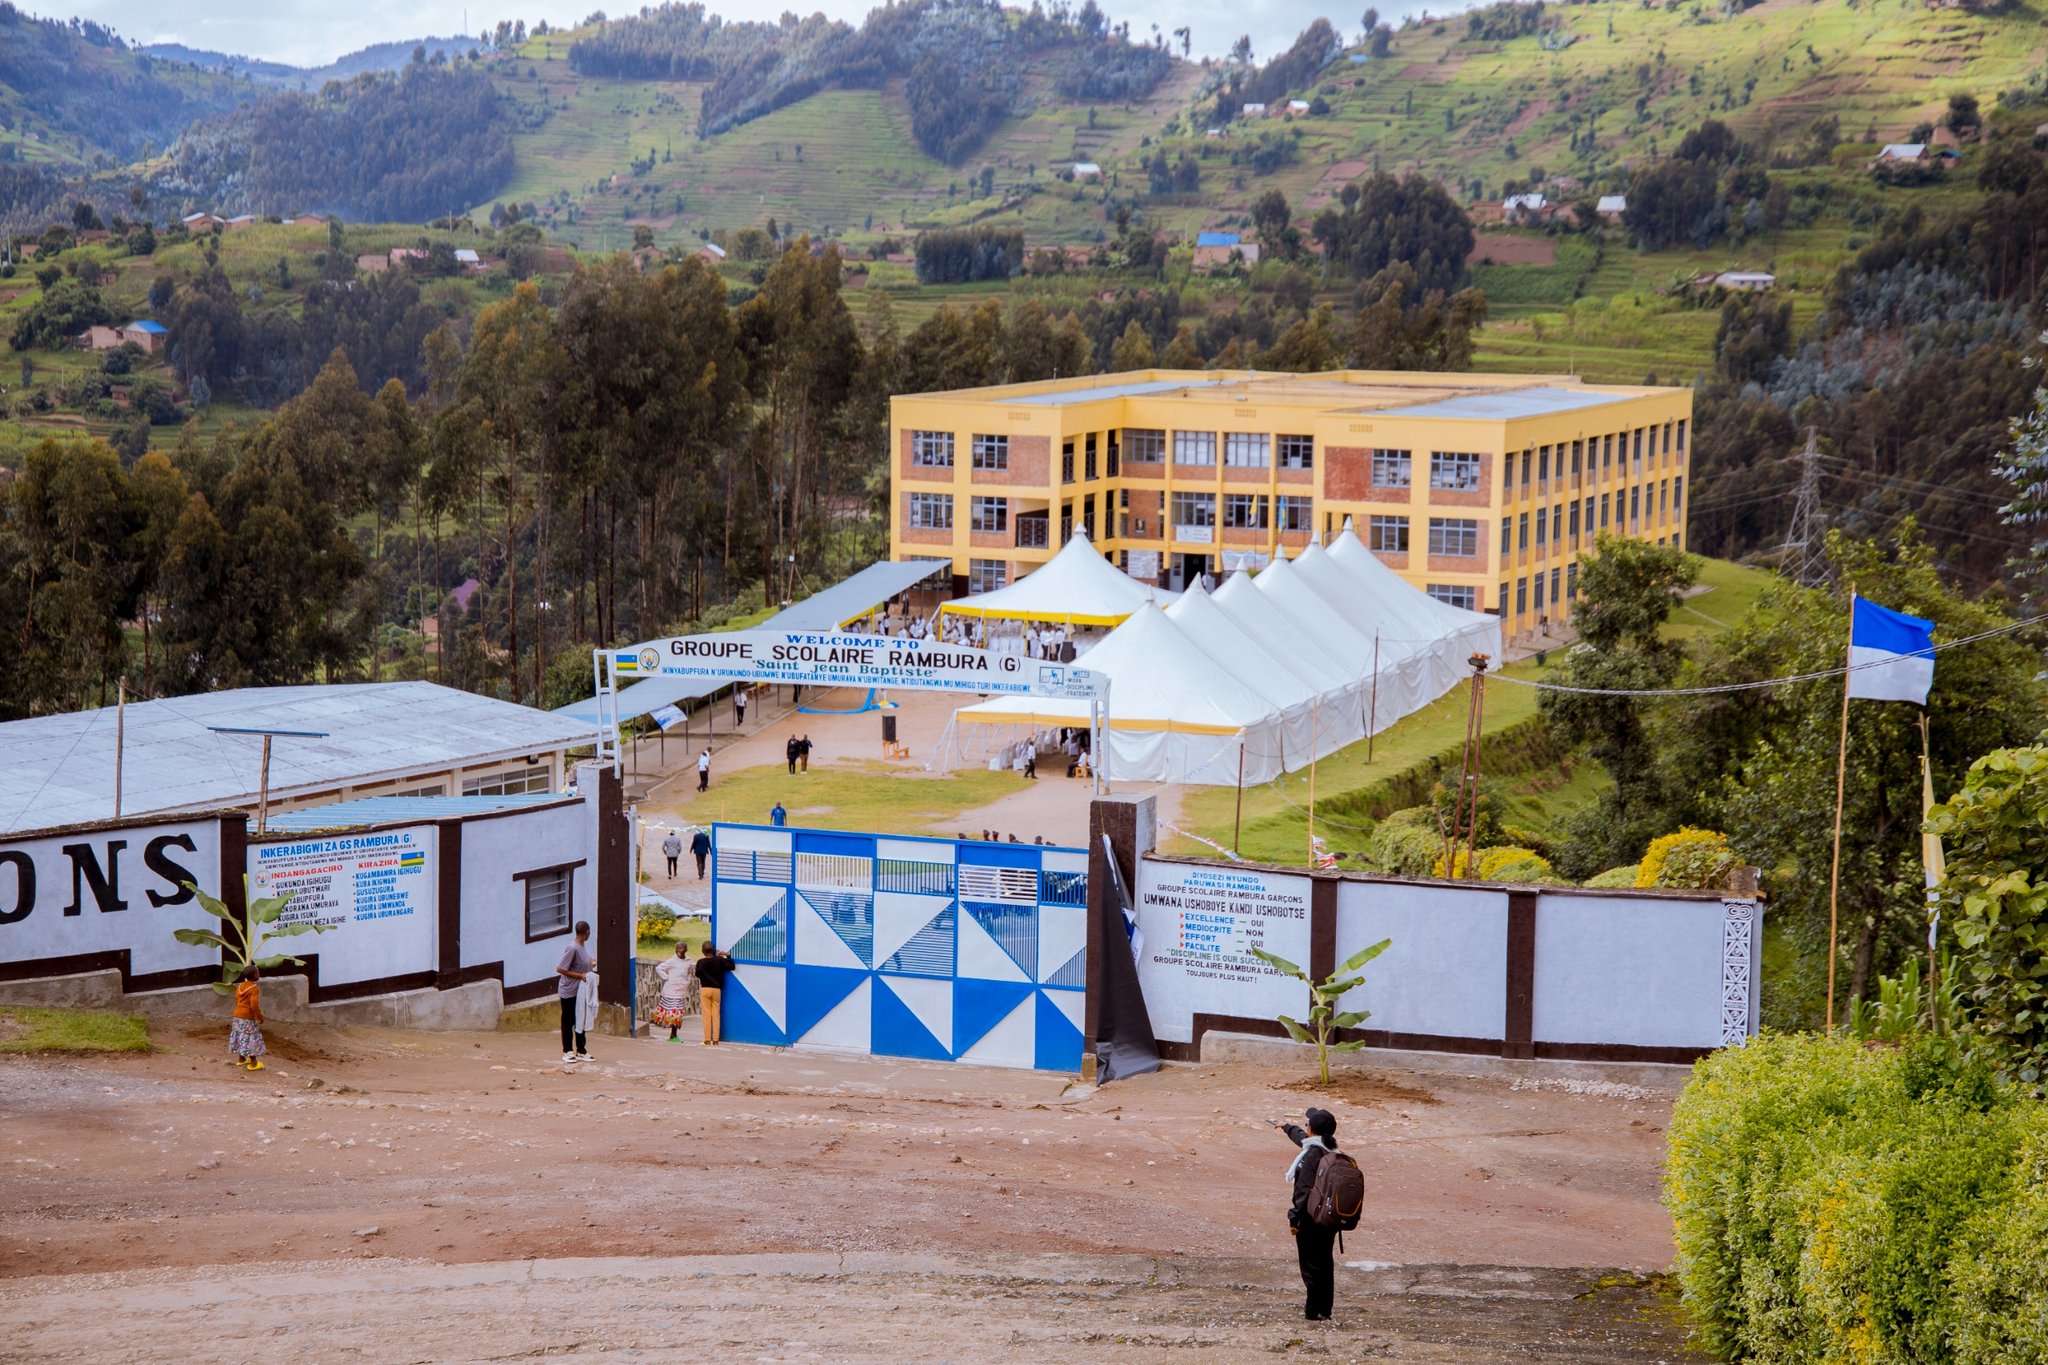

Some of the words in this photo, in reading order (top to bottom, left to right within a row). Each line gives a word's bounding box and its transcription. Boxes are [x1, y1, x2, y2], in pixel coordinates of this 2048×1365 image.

[786, 634, 884, 648] WELCOME
[892, 640, 919, 649] TO
[671, 640, 752, 658] GROUPE
[772, 645, 874, 664] SCOLAIRE
[889, 651, 988, 670] RAMBURA
[999, 657, 1022, 672] (G)
[662, 666, 709, 676] IKINYABUPFURA
[781, 672, 826, 681] N'UBUFATANYE
[828, 674, 856, 682] UMURAVA
[902, 678, 942, 688] NTIDUTANGWA
[944, 680, 953, 688] MU
[954, 681, 976, 690] MIHIGO
[977, 682, 990, 690] TURI
[260, 842, 323, 858] INKERABIGWI
[325, 841, 338, 852] ZA
[340, 840, 352, 850] GS
[354, 834, 399, 848] RAMBURA
[358, 858, 398, 868] KIRAZIRA
[272, 864, 342, 878] INDANGAGACIRO
[356, 869, 396, 880] KUGAMBANIRA
[398, 866, 422, 876] IGIHUGU
[276, 879, 306, 889] GUKUNDA
[307, 876, 332, 886] IGIHUGU
[356, 880, 370, 888] KUBA
[1192, 872, 1224, 880] DIYOSEZI
[1226, 875, 1259, 884] NYUNDO
[300, 885, 330, 894] UBUTWARI
[356, 886, 394, 896] GUSUZUGURA
[1184, 879, 1224, 888] PARUWASI
[1226, 882, 1266, 892] RAMBURA
[356, 896, 376, 904] KUGIRA
[378, 892, 408, 902] UBUNEBWE
[1158, 884, 1186, 894] GROUPE
[1188, 888, 1226, 898] SCOLAIRE
[1228, 891, 1266, 900] RAMBURA
[1268, 894, 1302, 904] GARÇONS
[310, 900, 339, 910] UMURAVA
[356, 904, 376, 912] KUGIRA
[378, 900, 405, 910] UMWANDA
[1144, 893, 1182, 908] UMWANA
[1184, 898, 1226, 912] USHOBOYE
[1229, 902, 1252, 914] KANDI
[1256, 904, 1304, 920] USHOBOTSE
[331, 916, 346, 924] IGIHE
[356, 912, 376, 920] KUGIRA
[378, 907, 414, 918] UBURANGARE
[1185, 913, 1234, 924] EXCELLENCE
[1251, 920, 1264, 928] OUI
[1185, 923, 1232, 934] MEDIOCRITE
[1246, 929, 1264, 937] NON
[1185, 942, 1220, 952] FACILITE
[1186, 933, 1216, 942] EFFORT
[1250, 940, 1264, 948] OUI
[1154, 956, 1183, 966] GROUPE
[1186, 960, 1222, 970] SCOLAIRE
[1224, 964, 1262, 974] RAMBURA
[1222, 956, 1238, 964] OUR
[1186, 970, 1218, 978] TOUJOURS
[1220, 973, 1236, 981] PLUS
